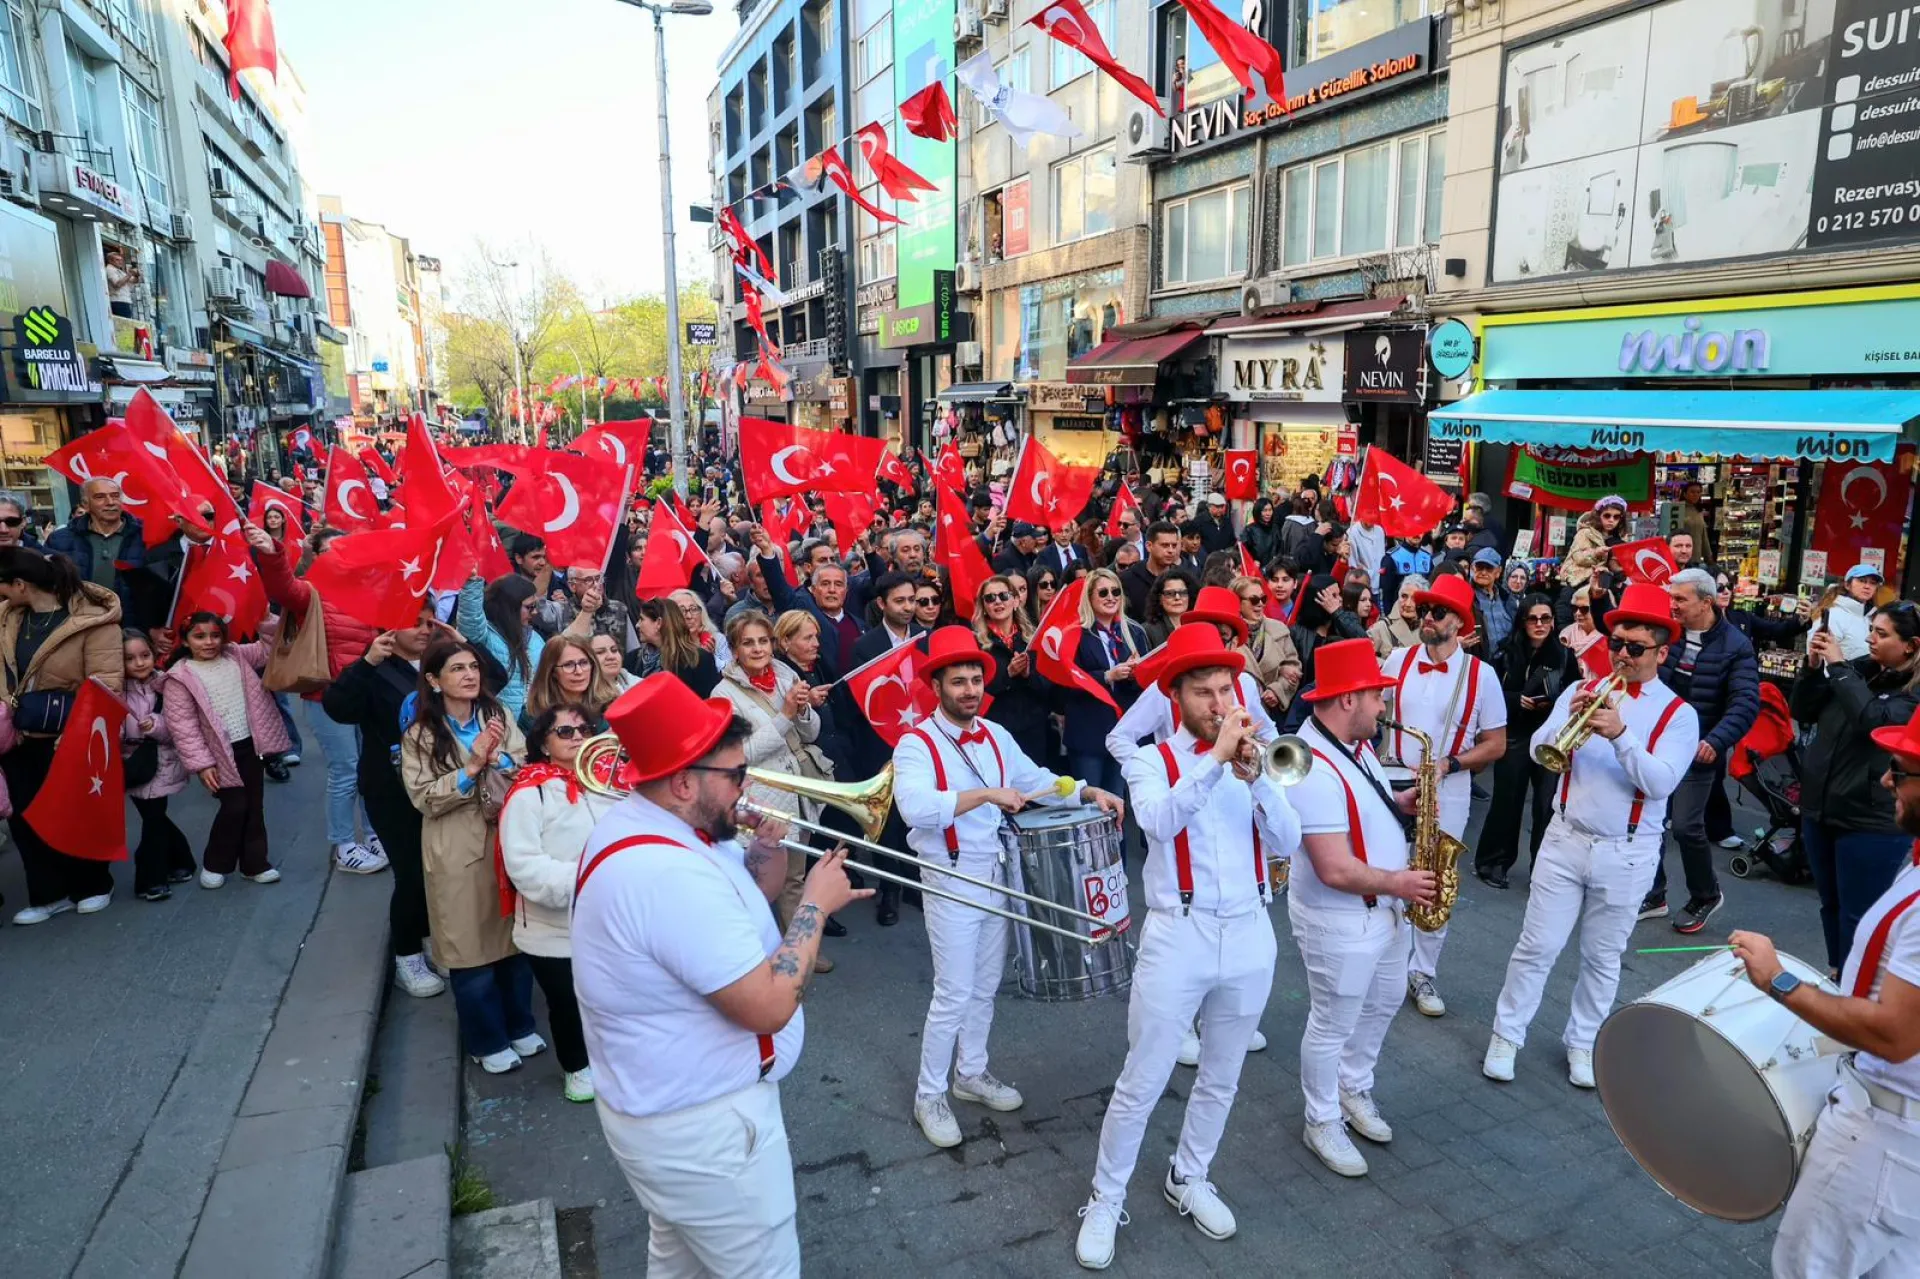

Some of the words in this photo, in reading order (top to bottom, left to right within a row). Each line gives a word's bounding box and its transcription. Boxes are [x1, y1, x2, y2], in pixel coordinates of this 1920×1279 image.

[1307, 87, 1316, 104] &
[1319, 67, 1369, 100] Güzellik
[1371, 54, 1417, 82] Salonu
[1171, 93, 1239, 152] NEVIN
[1817, 216, 1828, 233] 0
[1832, 211, 1865, 231] 212
[1869, 206, 1904, 227] 570
[23, 349, 71, 361] BARGELLO
[1619, 317, 1770, 373] mion
[1233, 357, 1324, 391] MYRA
[1360, 371, 1404, 388] NEVIN
[1442, 421, 1482, 438] mion
[1591, 425, 1645, 446] mion
[1796, 431, 1870, 456] mion
[1547, 465, 1617, 488] BİZDEN
